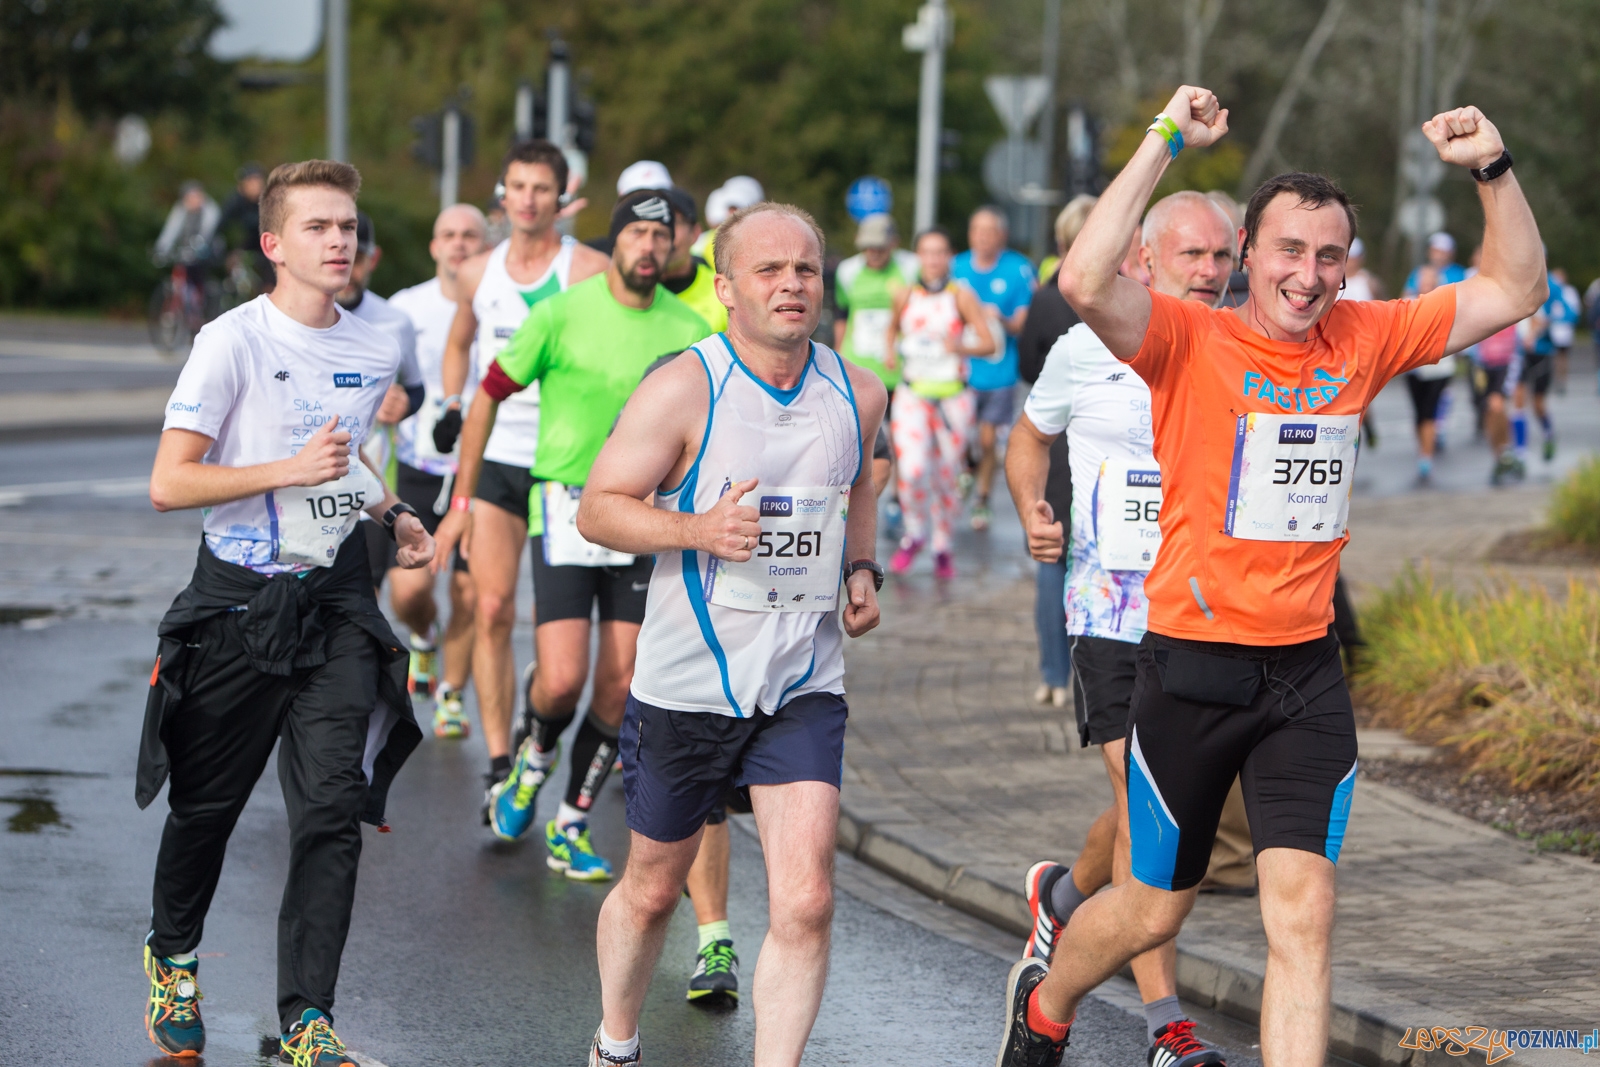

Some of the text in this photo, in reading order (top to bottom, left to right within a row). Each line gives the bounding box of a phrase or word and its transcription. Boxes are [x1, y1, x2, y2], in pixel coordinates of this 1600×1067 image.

[293, 398, 323, 412] SIŁA
[1242, 370, 1340, 413] FASTER
[1272, 458, 1343, 485] 3769
[305, 491, 365, 520] 1035
[1287, 492, 1329, 504] Konrad
[757, 531, 822, 558] 5261
[768, 565, 808, 576] Roman
